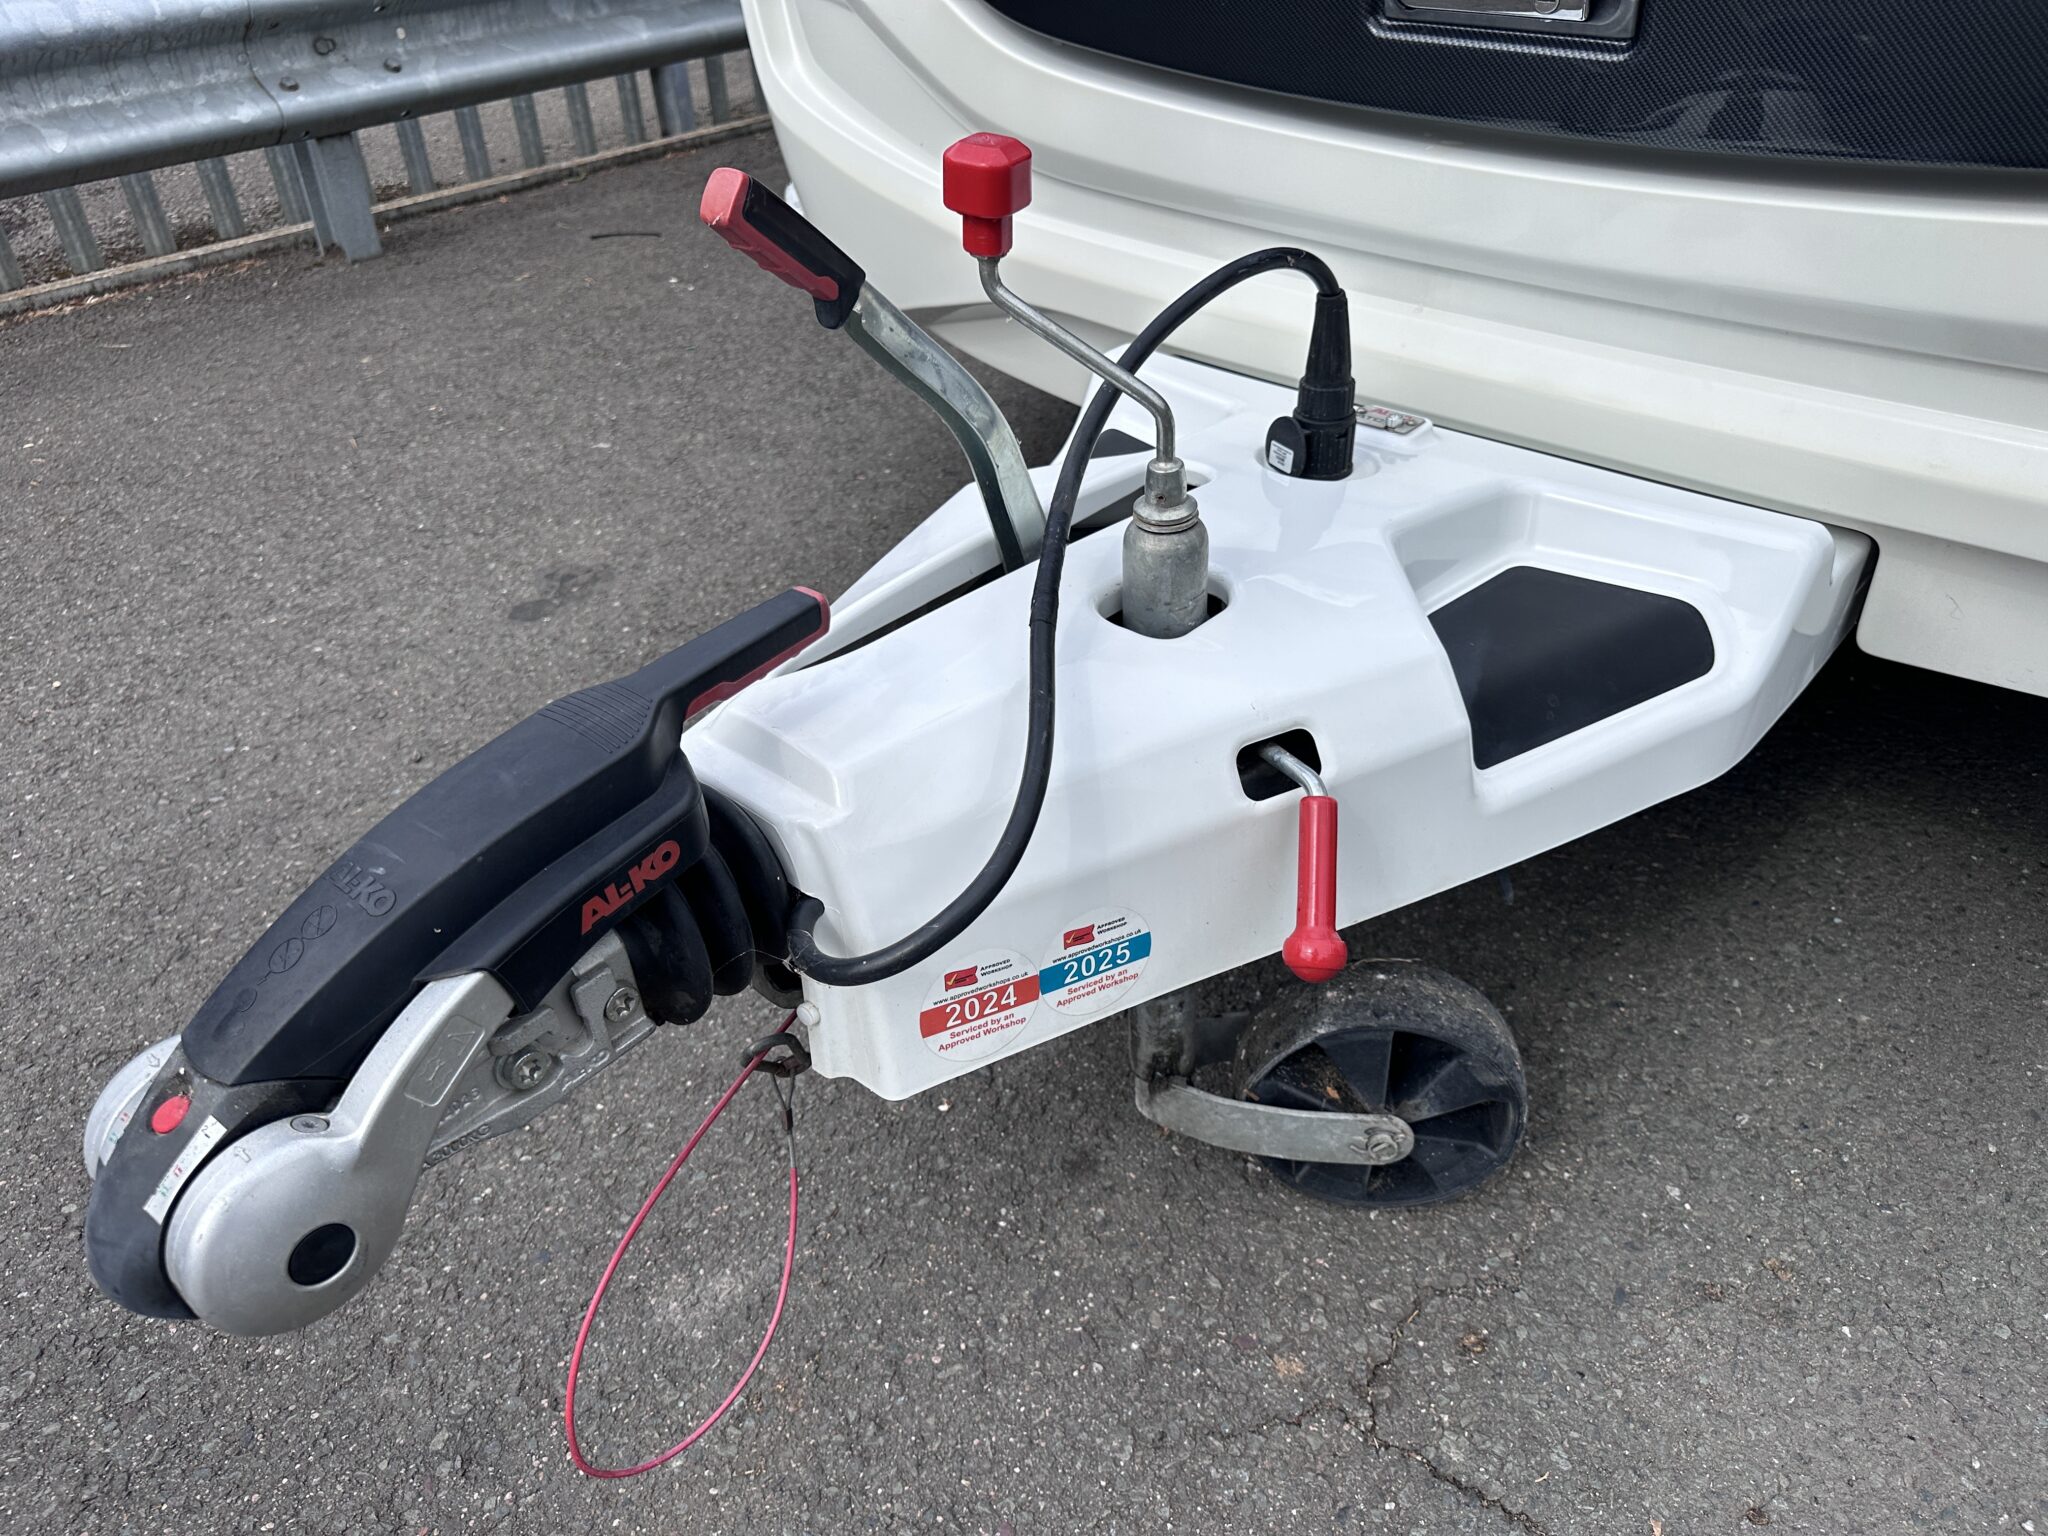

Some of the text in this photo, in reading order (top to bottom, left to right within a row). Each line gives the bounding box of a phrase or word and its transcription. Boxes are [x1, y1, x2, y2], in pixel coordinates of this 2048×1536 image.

[581, 840, 681, 936] AL-KO
[1096, 916, 1126, 930] APPROVED
[1097, 921, 1128, 935] WORKSHOP
[980, 958, 1011, 972] APPROVED
[980, 963, 1013, 977] WORKSHOP
[1063, 941, 1131, 985] 2025
[1056, 972, 1139, 1008] Approved Workshop
[1067, 968, 1128, 996] Serviced by an
[945, 984, 1017, 1028] 2024
[938, 1016, 1027, 1052] Approved Workshop
[949, 1013, 1015, 1040] Serviced by an
